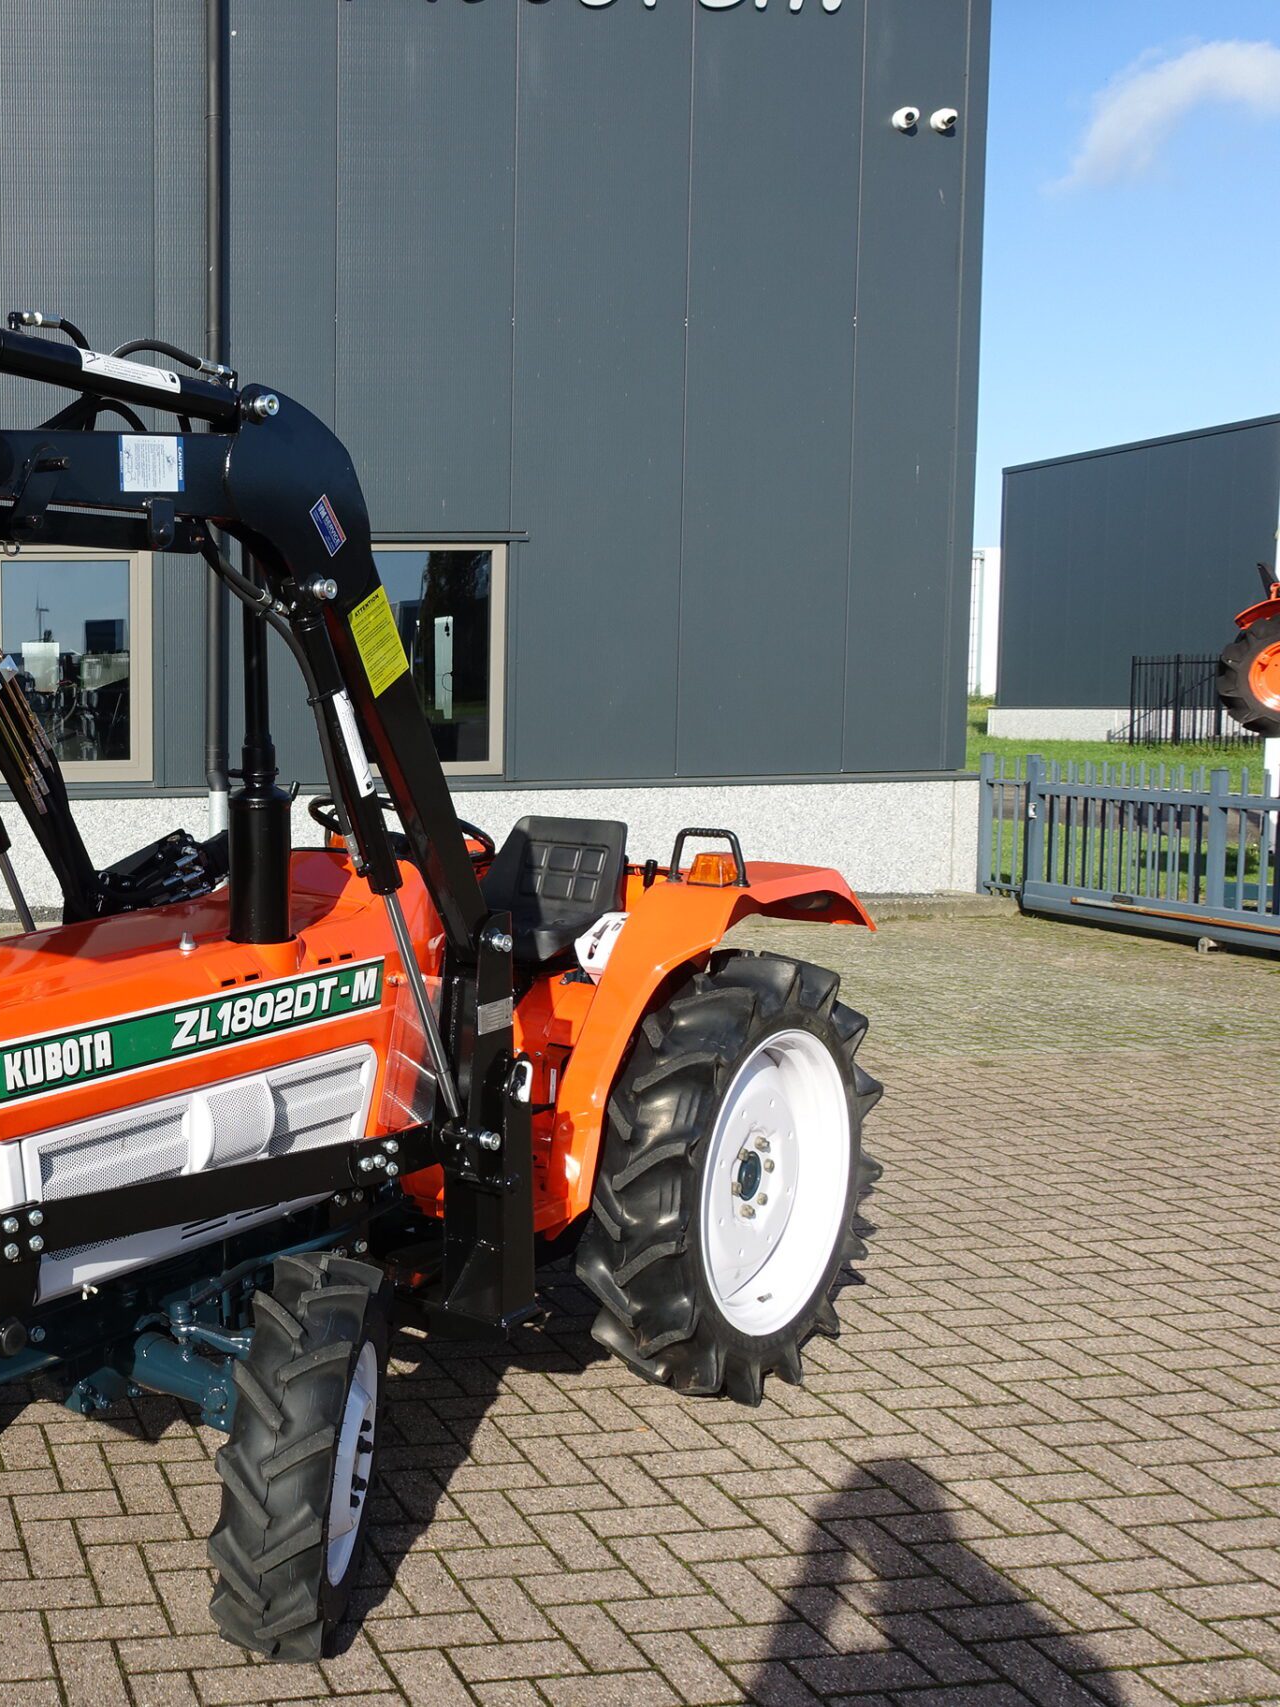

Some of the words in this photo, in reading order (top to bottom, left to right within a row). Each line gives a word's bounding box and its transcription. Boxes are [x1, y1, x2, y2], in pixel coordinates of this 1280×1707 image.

[323, 515, 341, 547] SERVICE
[354, 593, 380, 617] ATTENTION
[4, 1031, 112, 1091] KUBOTA
[171, 968, 378, 1050] ZL1802DT-M
